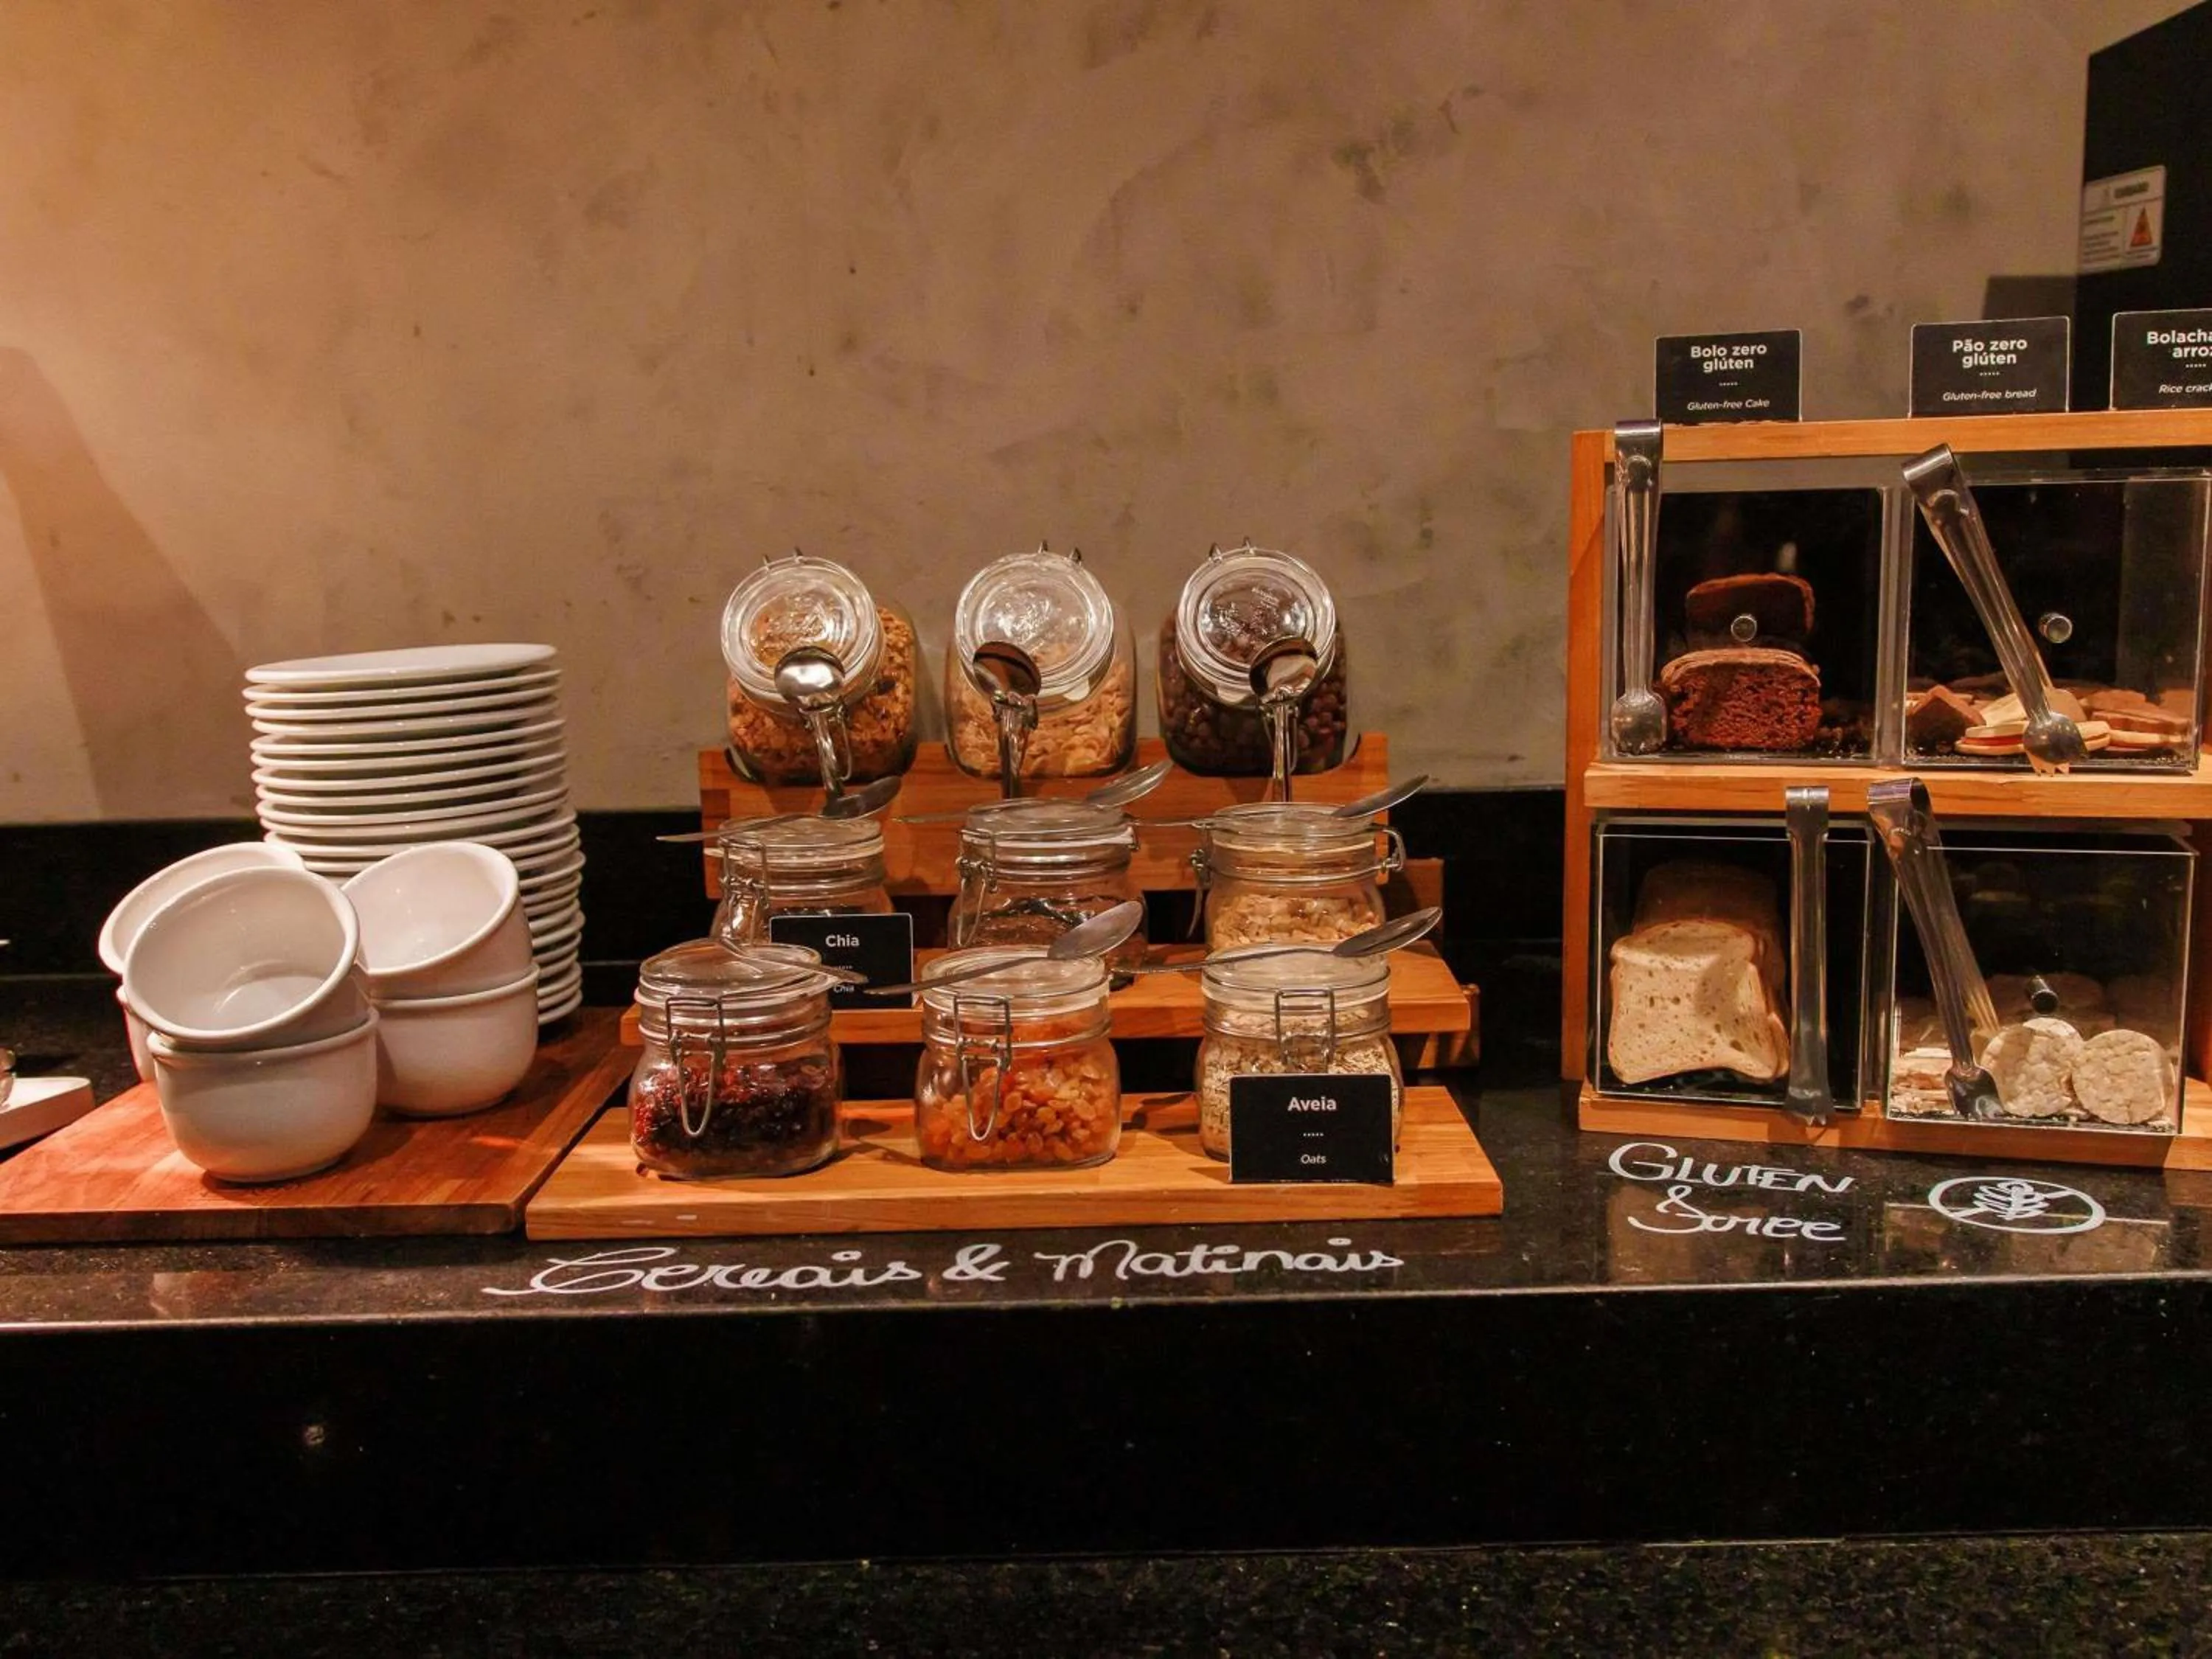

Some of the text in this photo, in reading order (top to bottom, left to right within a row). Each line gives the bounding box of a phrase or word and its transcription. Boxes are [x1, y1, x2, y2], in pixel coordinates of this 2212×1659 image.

[1691, 344, 1768, 358] Bolo zero
[1952, 338, 2028, 353] Pão zero
[1703, 358, 1754, 374] glúten
[1962, 352, 2017, 369] glúten
[1942, 388, 2037, 402] Gluten-free bread
[2158, 384, 2183, 394] Rice
[1687, 399, 1770, 411] Gluten-free Cake
[824, 933, 860, 947] Chia
[1287, 1096, 1338, 1112] Aveia
[1300, 1154, 1327, 1165] Oats
[481, 1237, 1405, 1296] Cereais & Matinais
